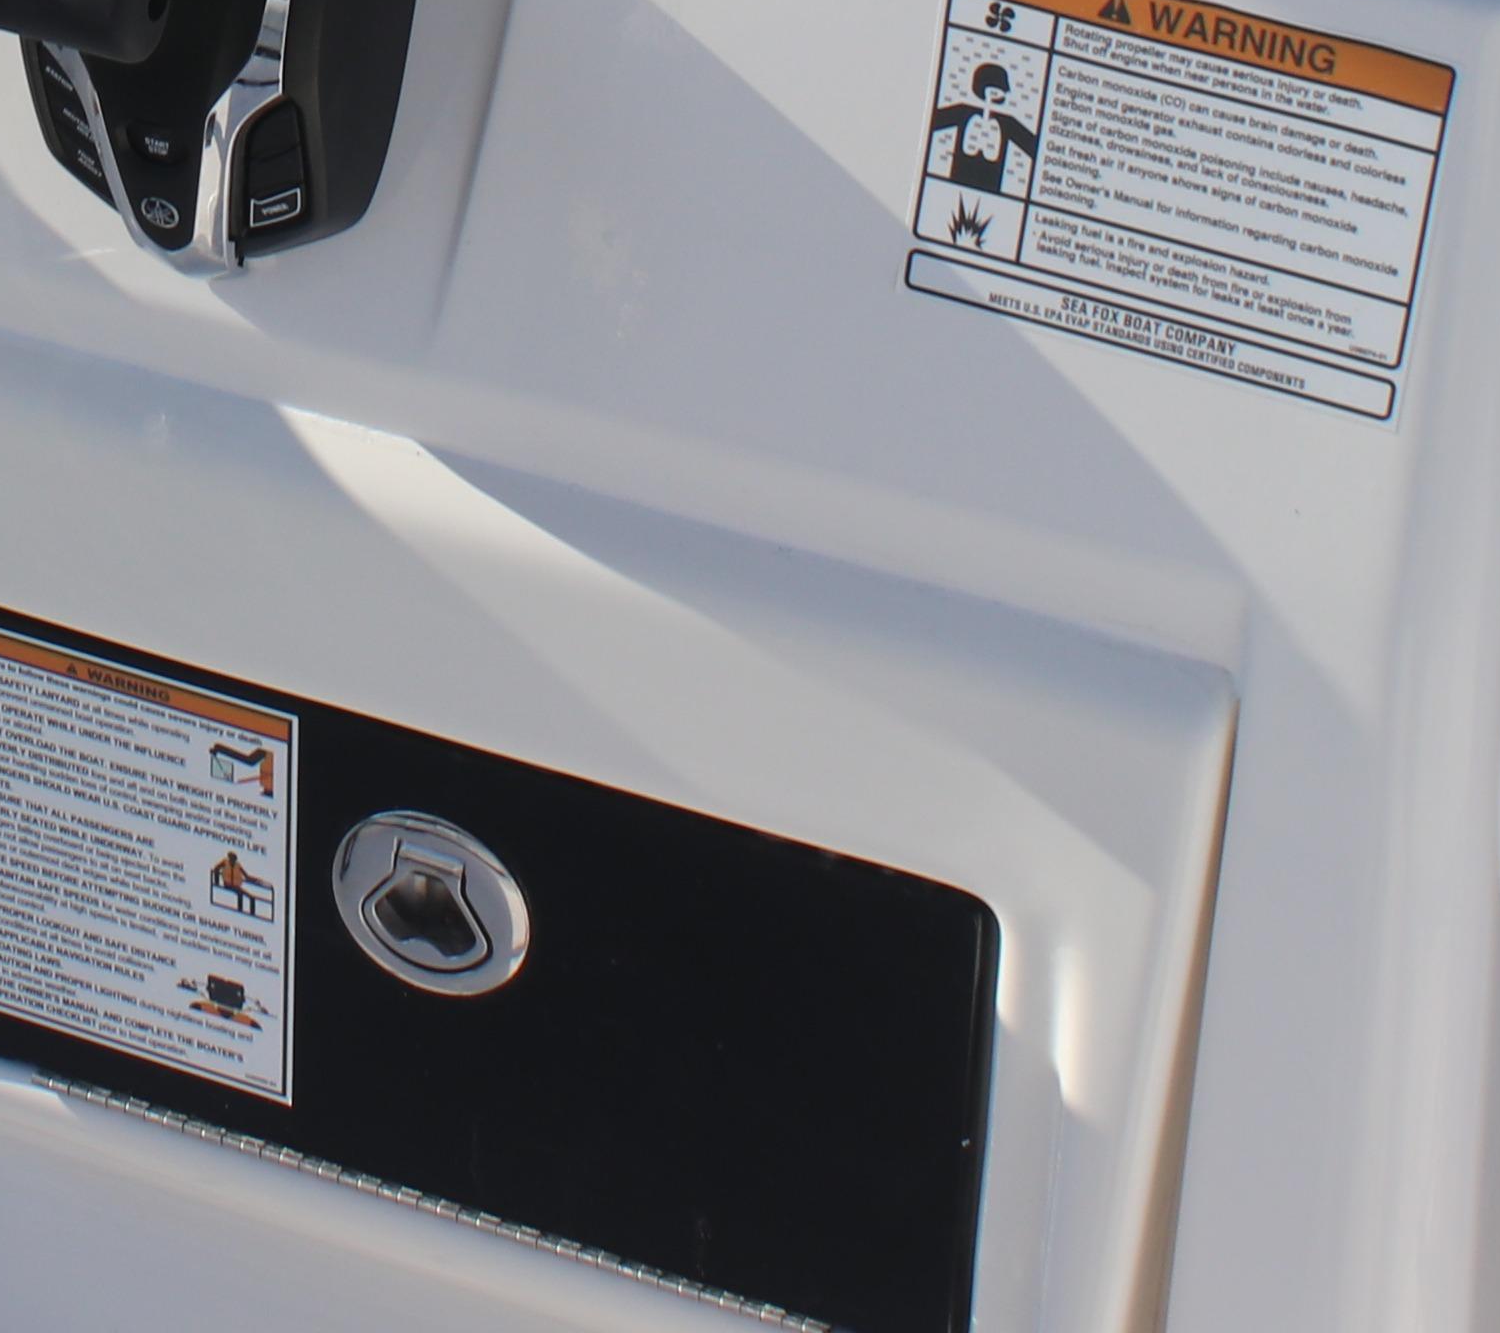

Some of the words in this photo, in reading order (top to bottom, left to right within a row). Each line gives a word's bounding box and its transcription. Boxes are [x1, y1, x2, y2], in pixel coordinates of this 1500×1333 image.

[1062, 35, 1090, 53] Shut
[1091, 45, 1110, 58] off
[1109, 51, 1149, 69] engine
[1151, 62, 1182, 77] when
[1184, 70, 1210, 84] near
[1211, 77, 1259, 98] persons
[1260, 87, 1273, 101] in
[1274, 92, 1294, 106] the
[1064, 23, 1113, 49] Rotating
[1114, 39, 1166, 60] propeller
[1168, 53, 1193, 69] may
[1195, 60, 1230, 76] cause
[1232, 69, 1275, 88] serious
[1277, 78, 1310, 99] injury
[1312, 89, 1326, 101] or
[1149, 0, 1337, 76] WARNING
[1053, 97, 1093, 115] carbon
[1095, 108, 1151, 131] monoxide
[1055, 82, 1095, 103] Engine
[1097, 96, 1119, 110] and
[1121, 103, 1176, 124] generator
[1178, 118, 1223, 137] exhaust
[1225, 130, 1275, 151] contains
[1277, 143, 1327, 165] odorless
[1329, 157, 1352, 171] and
[1353, 164, 1406, 186] colorless
[1057, 65, 1100, 87] Carbon
[1101, 79, 1158, 103] monoxide
[1160, 93, 1187, 112] (CO)
[1188, 103, 1210, 116] can
[1212, 109, 1247, 126] cause
[1248, 116, 1279, 134] brain
[1280, 125, 1327, 147] damage
[1328, 139, 1341, 150] or
[1034, 212, 1079, 236] Leaking
[1081, 225, 1102, 240] fuel
[1105, 233, 1115, 243] is
[1127, 237, 1146, 252] fire
[1148, 245, 1170, 259] and
[1171, 251, 1227, 273] explosion
[988, 292, 1021, 311] MEETS
[1044, 307, 1063, 322] EPA
[1065, 313, 1091, 329] EVAP
[1093, 321, 1151, 347] STANDARDS
[1153, 340, 1184, 356] USING
[1186, 347, 1235, 370] CERTIFIED
[1237, 362, 1305, 390] COMPONENTS
[1061, 296, 1088, 316] SEA
[1092, 304, 1119, 324] FOX
[1123, 313, 1161, 336] BOAT
[1165, 325, 1236, 356] COMPANY
[87, 667, 170, 703] WARNING
